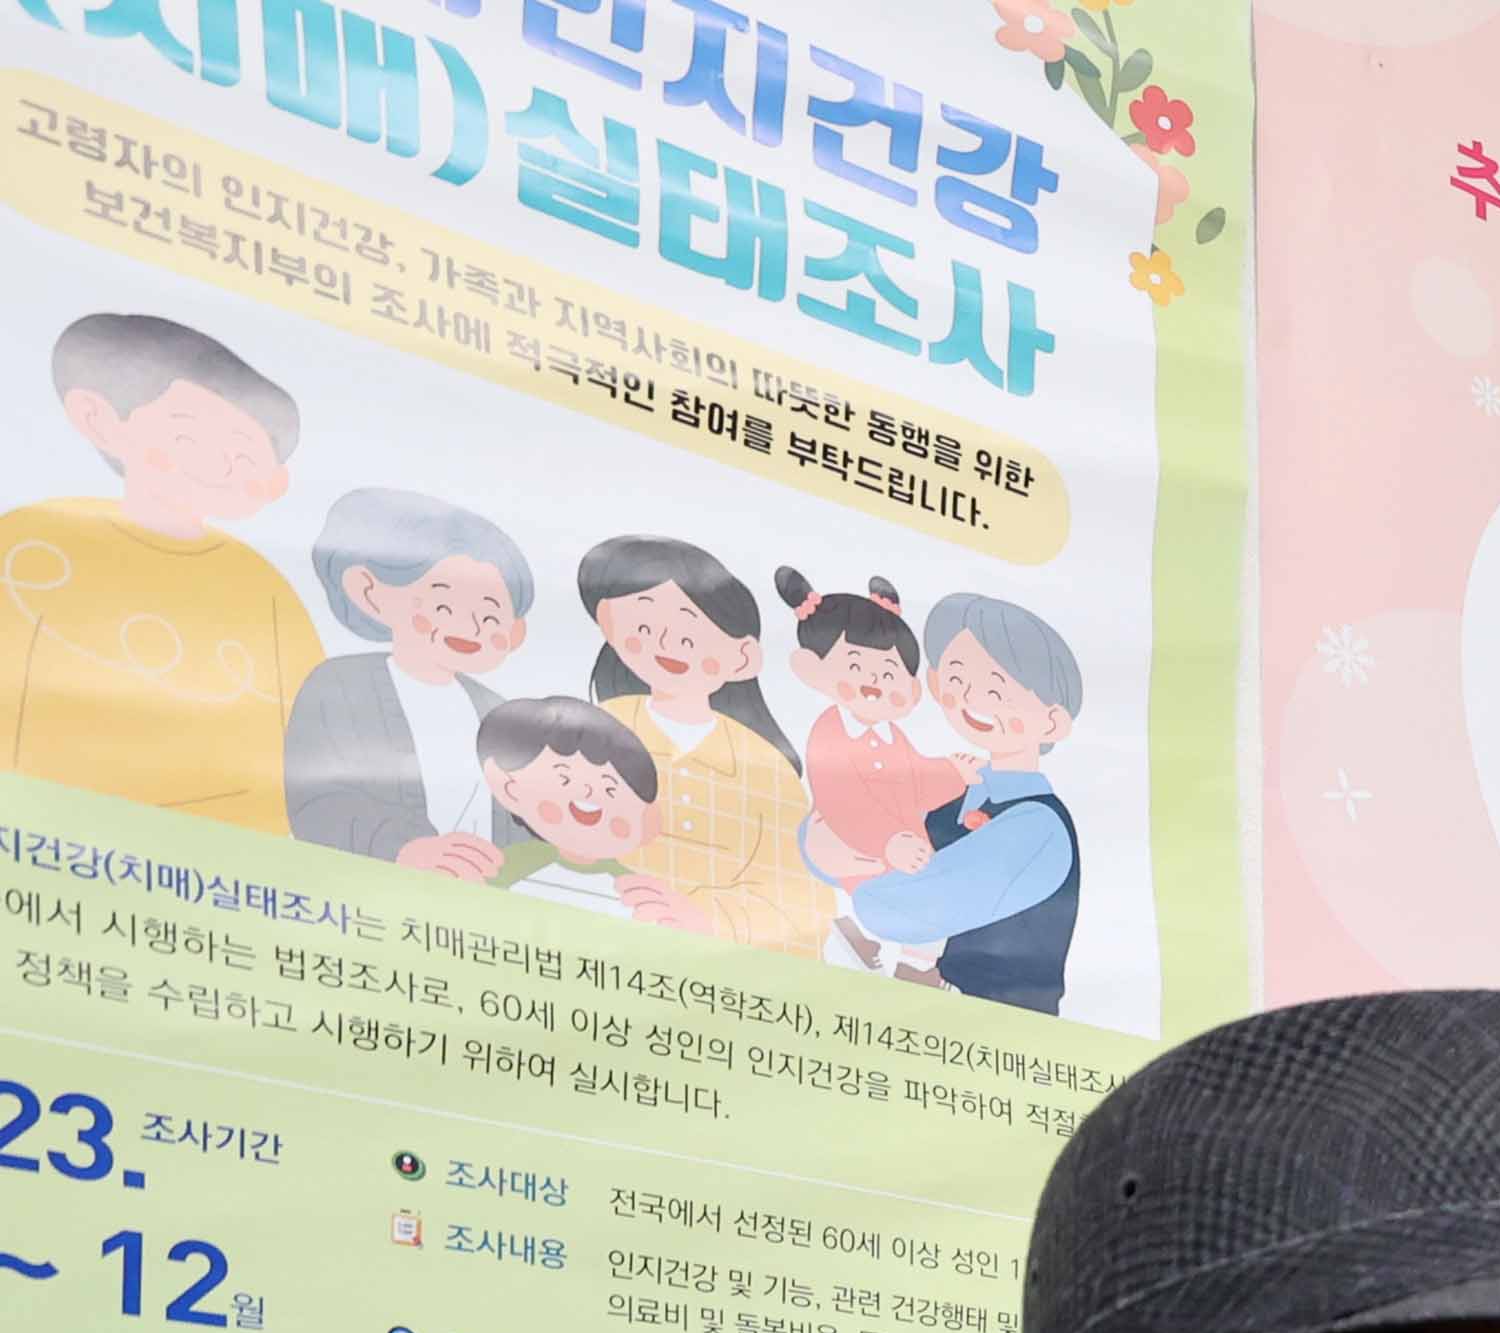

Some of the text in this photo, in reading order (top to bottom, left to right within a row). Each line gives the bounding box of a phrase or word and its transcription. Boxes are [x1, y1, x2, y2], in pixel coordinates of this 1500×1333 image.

[16, 97, 1035, 499] 고령자의 인지건강, 가족과 지역사회의 따뜻한 동행을 위한
[83, 179, 990, 531] 보건복지부의 조사에 적극적인 참여를 부탁드립니다.
[401, 920, 562, 982] 치매관리법
[15, 949, 731, 1121] 정책을 수립하고 시행하기 위하여 실시합니다.
[102, 910, 256, 971] 시행하는
[275, 944, 465, 1015] 법정조사로,
[480, 989, 556, 1032] 60세
[571, 1007, 632, 1049] 이상
[645, 1023, 733, 1072] 성인의
[747, 1045, 890, 1101] 인지건강을
[904, 1079, 1013, 1126] 파악하여
[140, 1111, 284, 1165] 조사기간
[445, 1160, 569, 1207] 조사대상
[444, 1224, 569, 1270] 조사내용
[608, 1186, 1000, 1279] 전국에서 선정된 60세 이상 성인
[606, 1293, 689, 1331] 의료비
[607, 1248, 718, 1295] 인지건강
[728, 1268, 753, 1299] 및
[763, 1273, 821, 1311] 기능,
[831, 1284, 883, 1318] 관련
